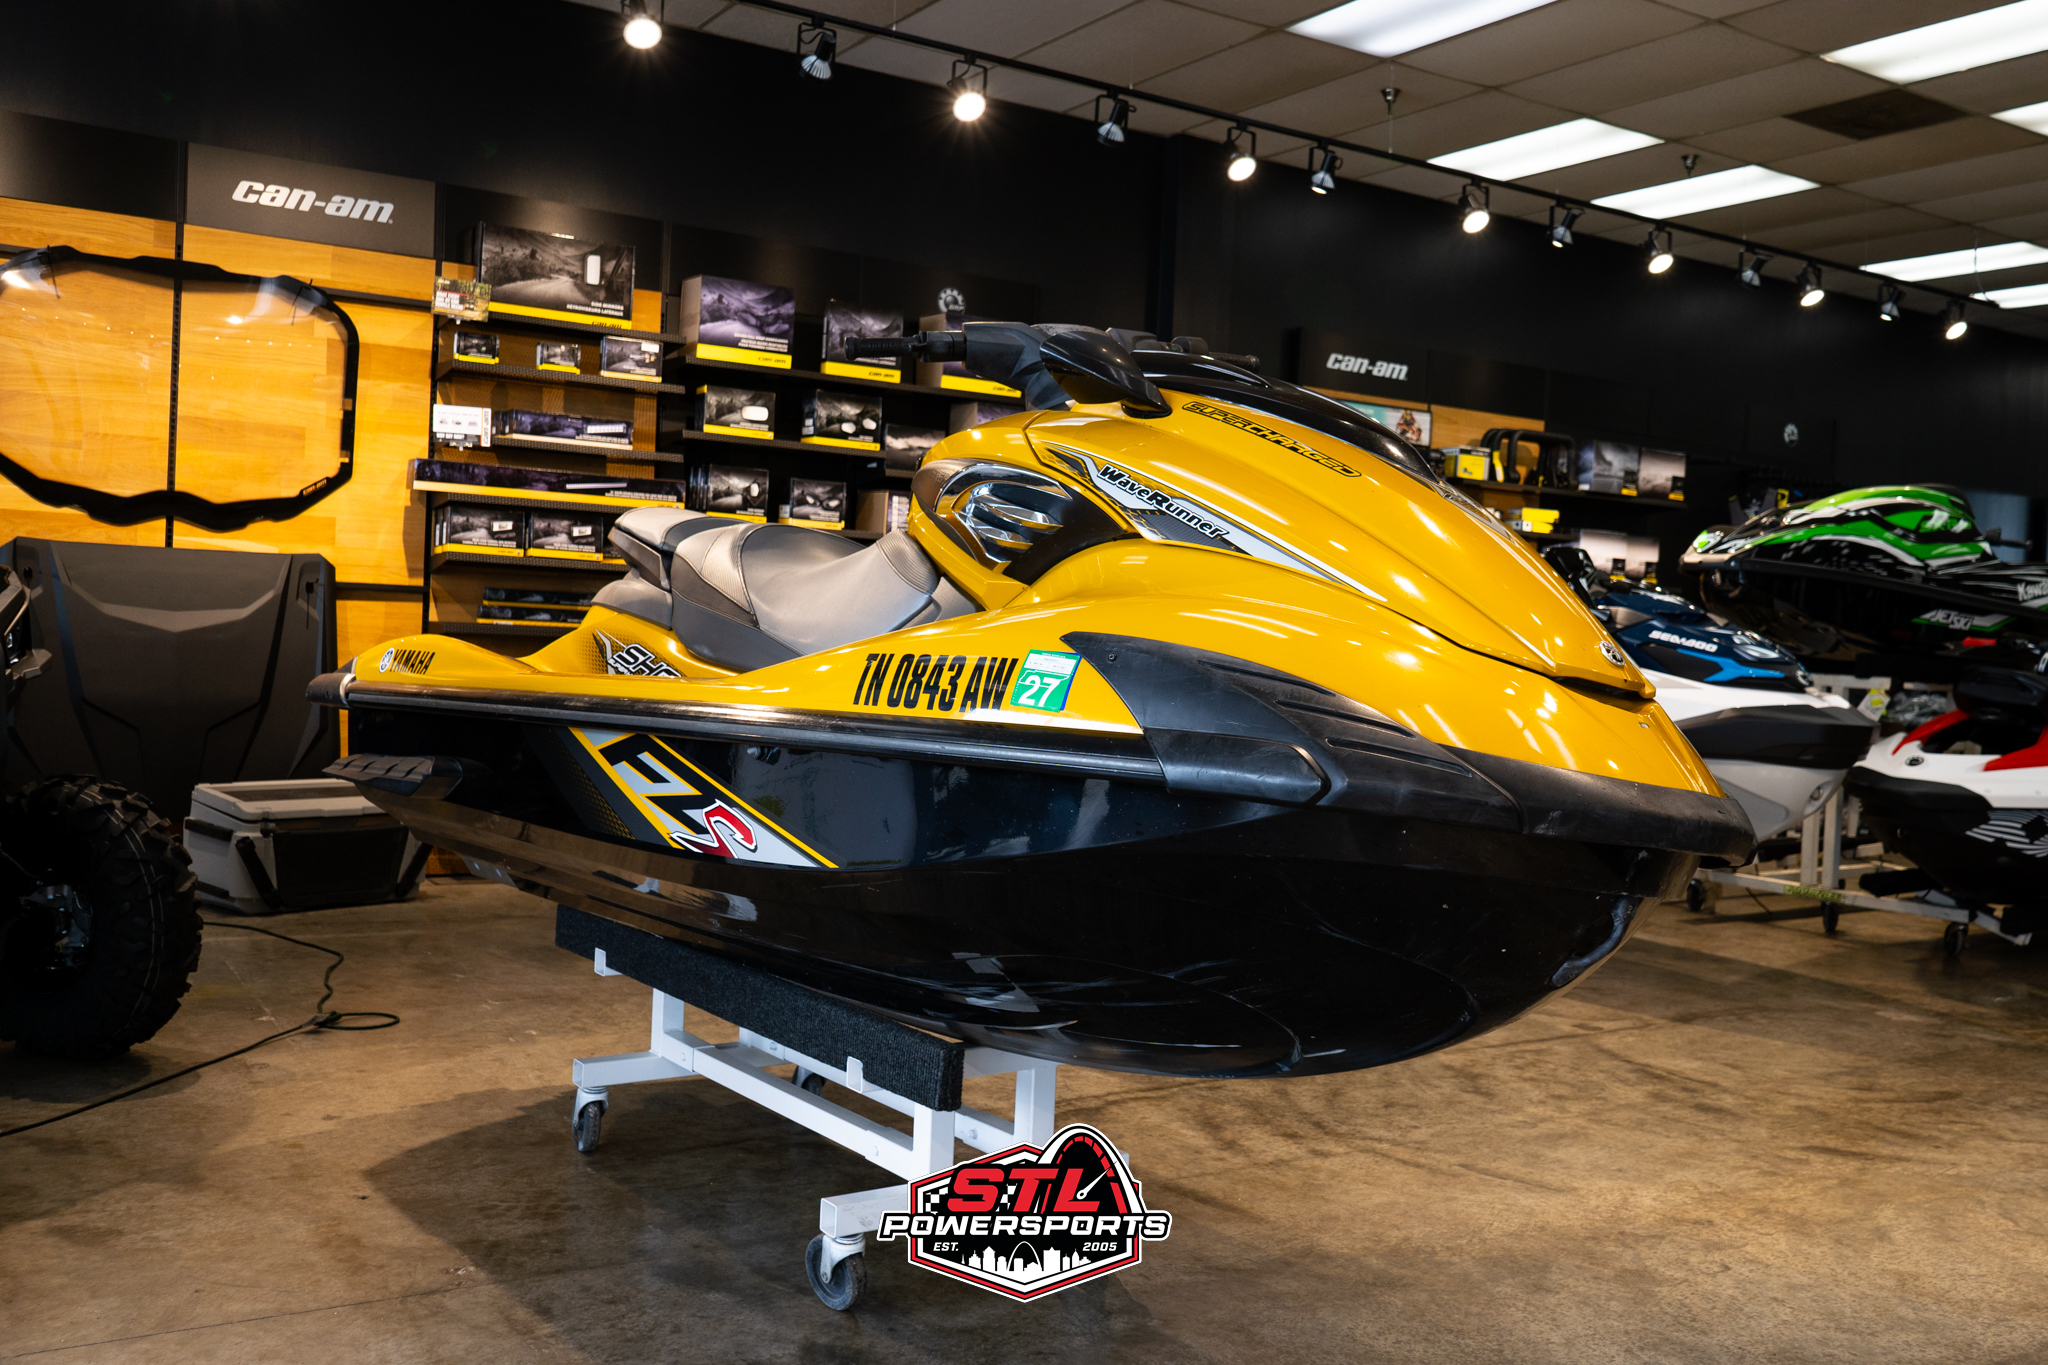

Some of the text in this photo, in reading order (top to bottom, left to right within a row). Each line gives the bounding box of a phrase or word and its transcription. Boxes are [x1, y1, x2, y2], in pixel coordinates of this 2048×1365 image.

[232, 180, 394, 224] can-am
[1326, 352, 1409, 381] can-am
[1184, 402, 1362, 477] SUPERCHARGED
[1098, 464, 1229, 539] WaveRunner
[390, 649, 436, 675] YAMAHA
[853, 653, 1019, 713] TN 0843 AW
[1018, 674, 1061, 708] 27
